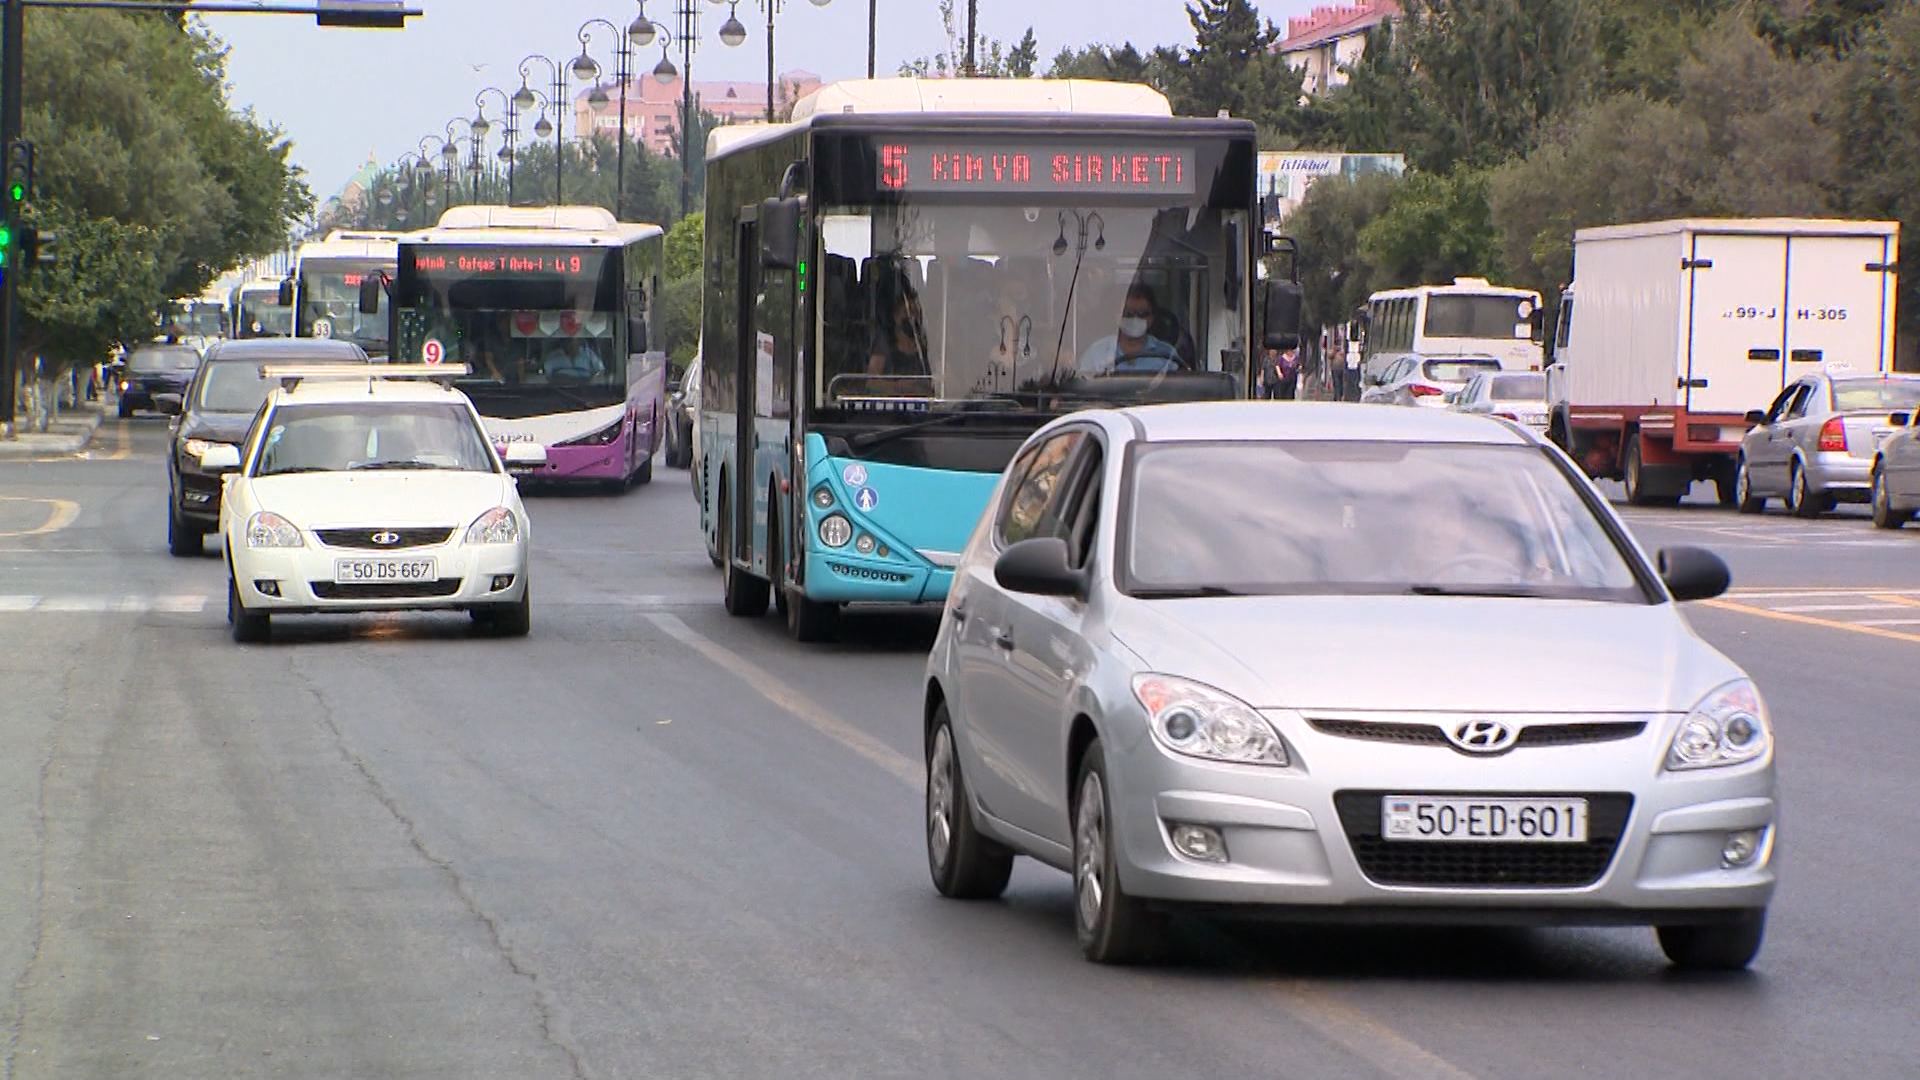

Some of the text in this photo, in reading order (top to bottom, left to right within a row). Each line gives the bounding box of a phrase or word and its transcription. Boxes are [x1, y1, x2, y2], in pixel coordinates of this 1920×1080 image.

[881, 144, 908, 190] 5
[570, 255, 581, 273] 9
[1797, 309, 1848, 320] H-305
[316, 323, 329, 336] 33
[426, 342, 440, 363] 9
